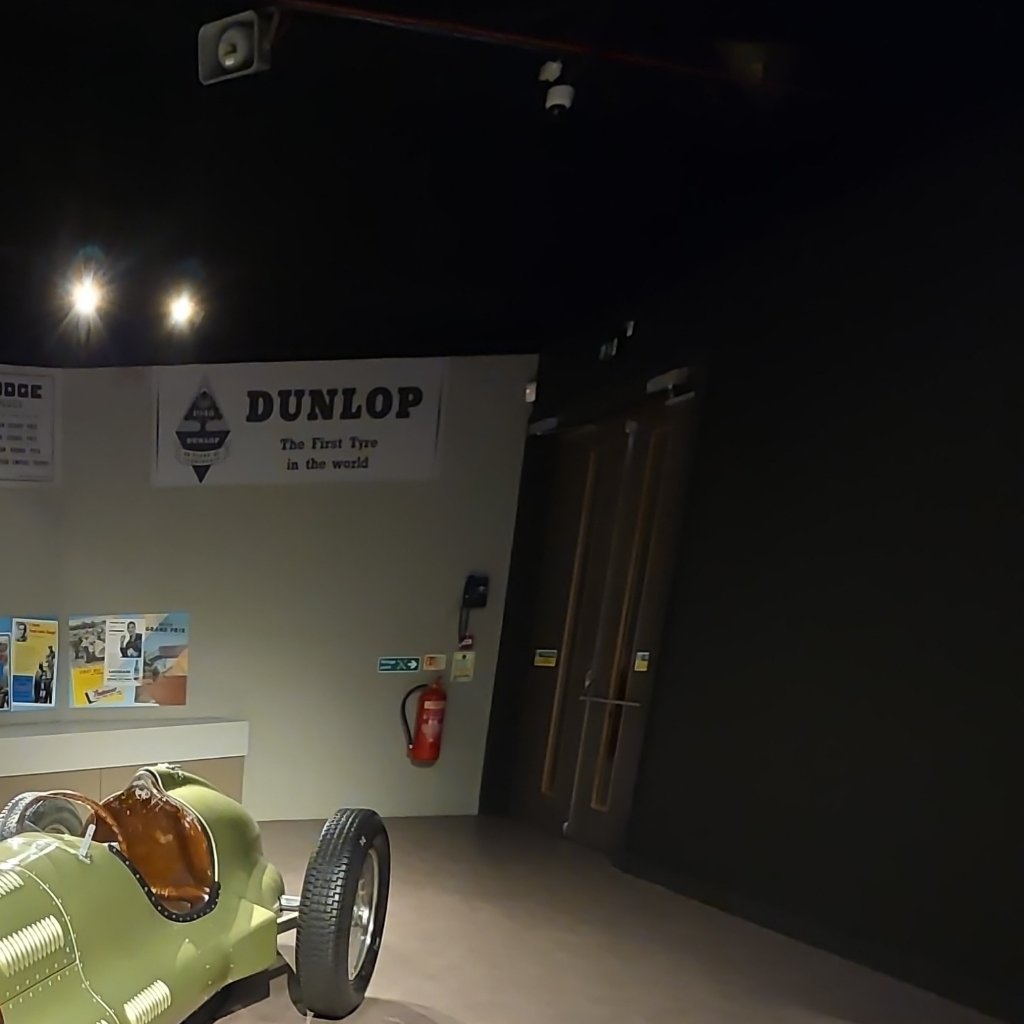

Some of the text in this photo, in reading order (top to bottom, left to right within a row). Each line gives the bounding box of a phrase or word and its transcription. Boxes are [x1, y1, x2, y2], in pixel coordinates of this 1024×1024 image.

[246, 386, 423, 422] DUNLOP
[280, 436, 378, 451] The First Tyre
[286, 456, 369, 471] in the world
